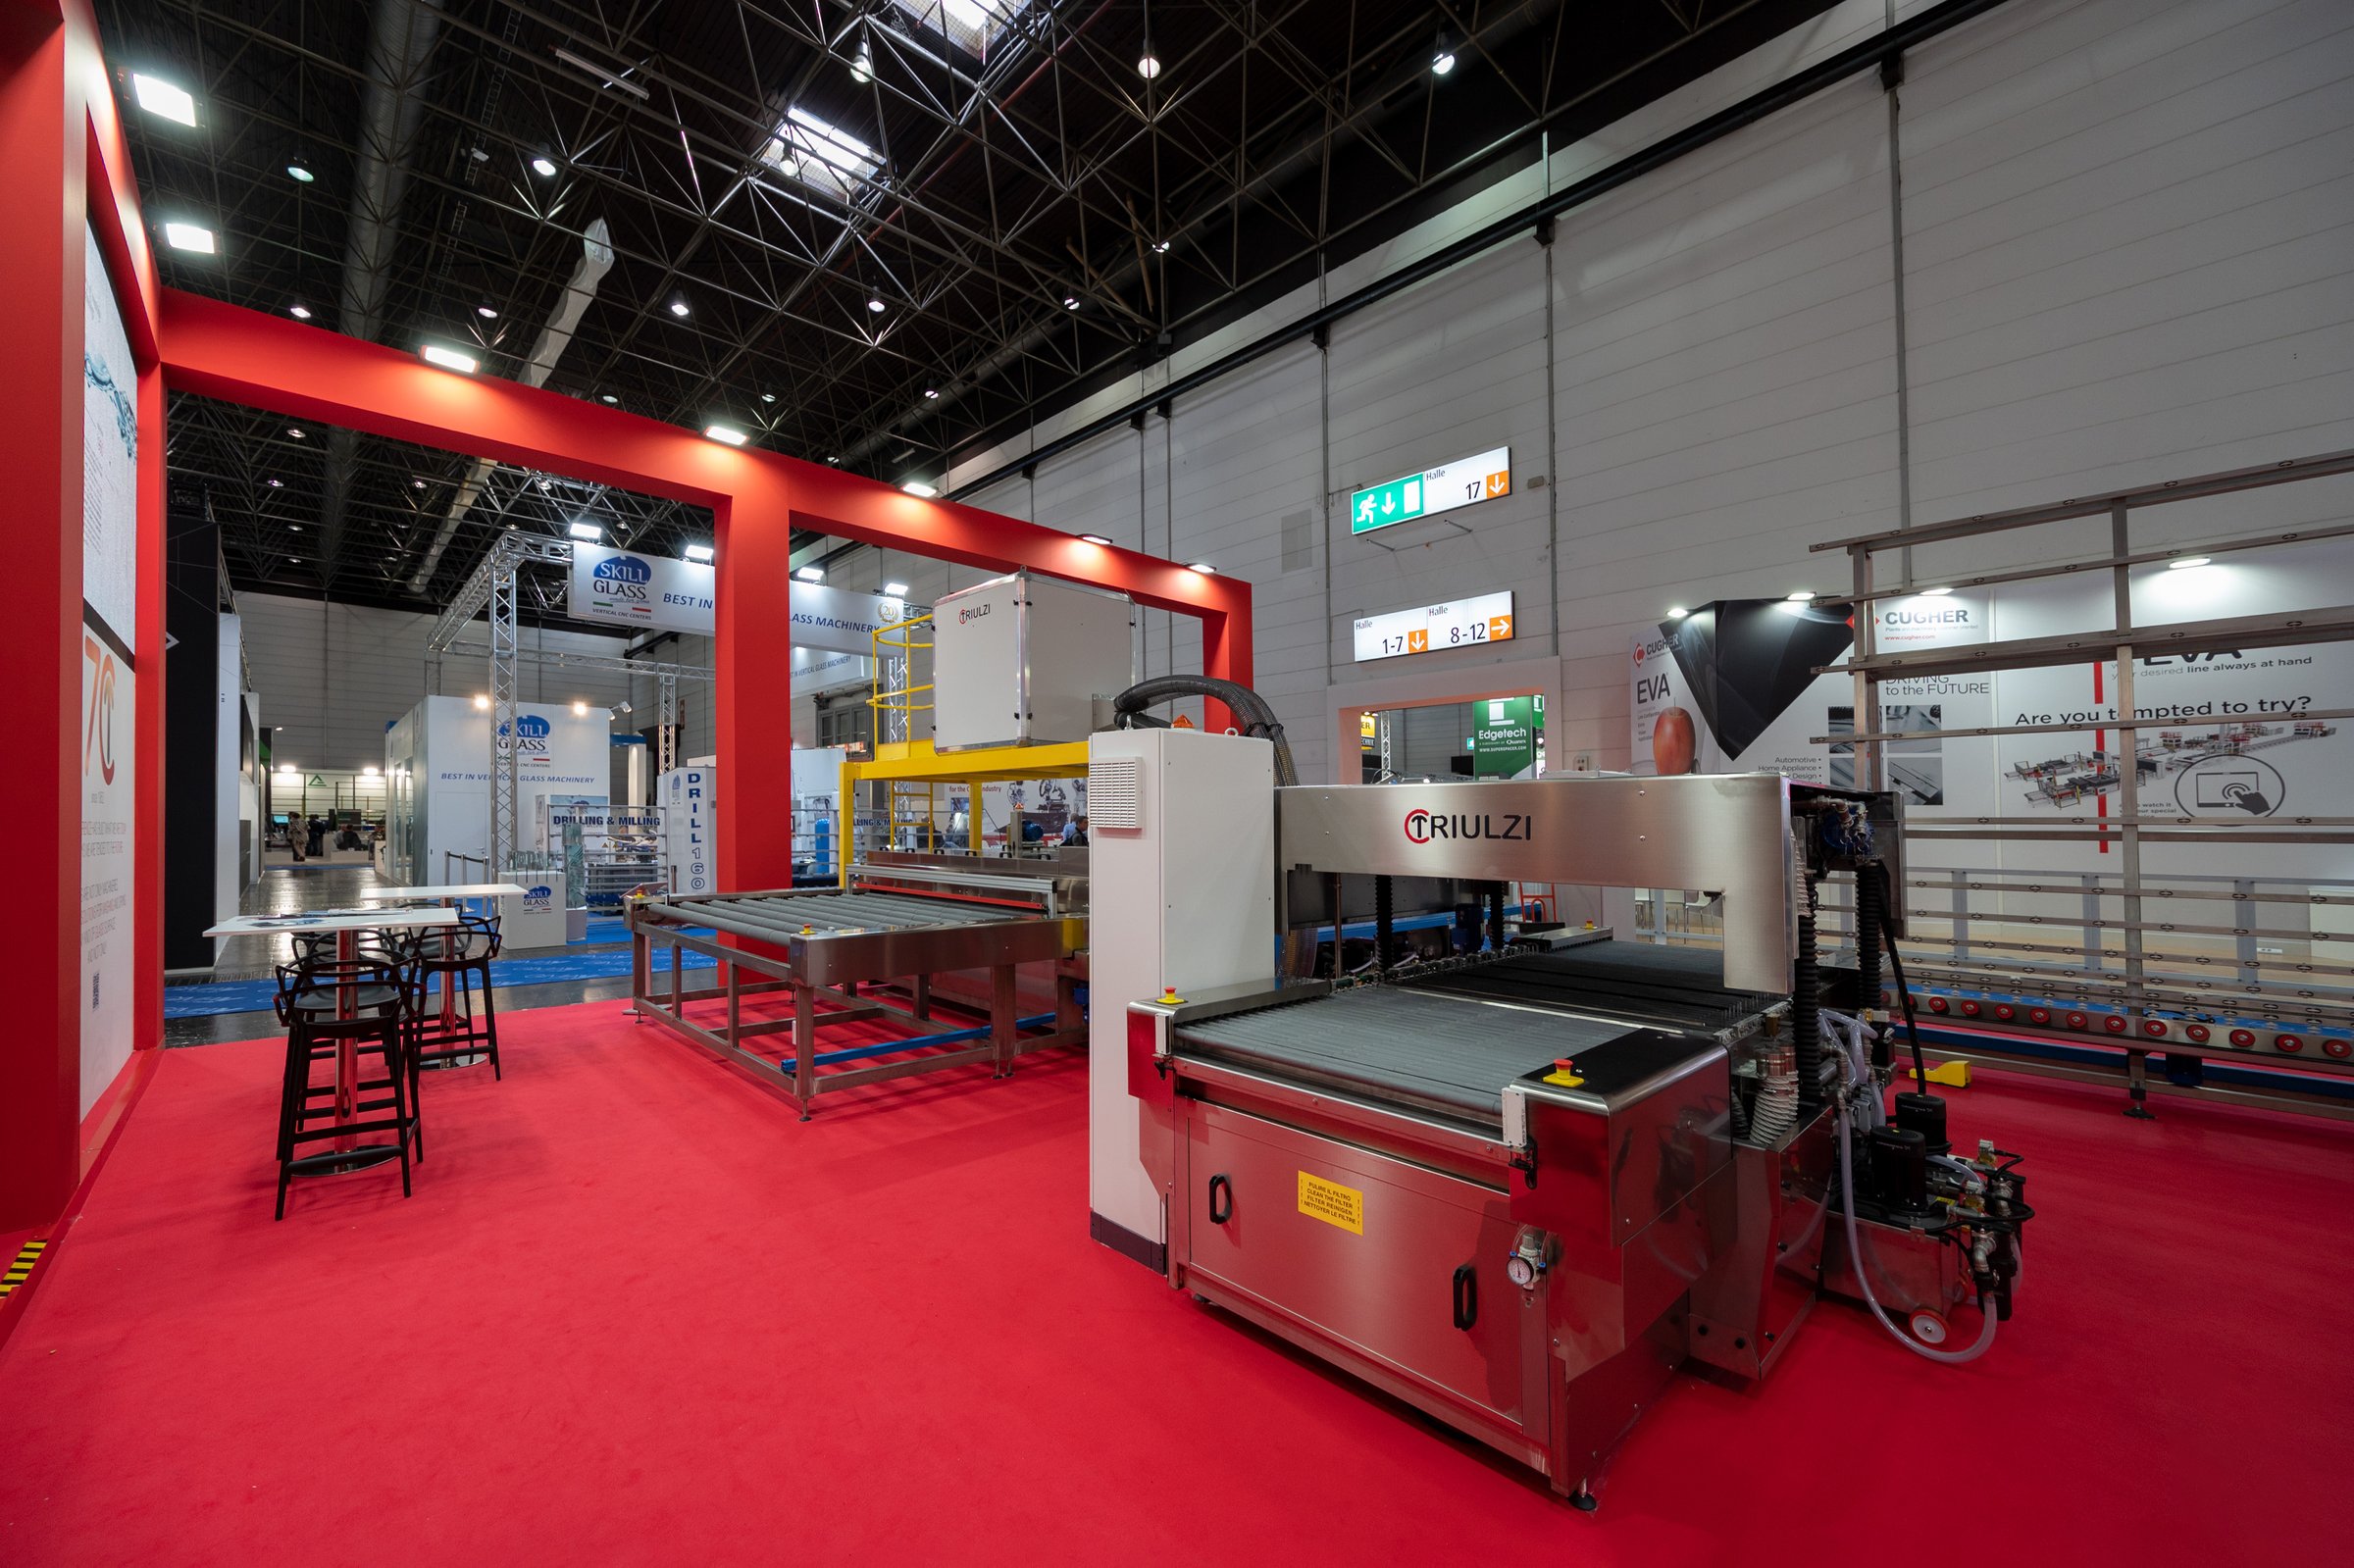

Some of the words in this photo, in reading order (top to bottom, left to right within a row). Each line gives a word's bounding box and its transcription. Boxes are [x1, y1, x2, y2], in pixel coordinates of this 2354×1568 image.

[1426, 469, 1446, 481] Halle
[1465, 481, 1481, 500] 17
[599, 562, 647, 583] SKILL
[593, 580, 646, 599] GLASS
[663, 593, 695, 607] BEST
[698, 598, 713, 609] IN
[959, 603, 991, 625] TRIULZI
[1429, 606, 1449, 617] Halle
[1884, 609, 1969, 626] CUGHER
[1356, 620, 1373, 630] Halle
[1382, 635, 1404, 654] 1-7
[1646, 633, 1679, 656] CUGHER
[827, 655, 851, 668] MACHINERY
[2140, 667, 2183, 677] desired
[2214, 662, 2257, 674] always
[2260, 659, 2273, 668] at
[2277, 655, 2312, 666] hand
[1637, 673, 1670, 704] EVA
[1886, 686, 1899, 695] to
[1903, 685, 1923, 695] the
[1927, 683, 1990, 694] FUTURE
[2015, 711, 2052, 727] Are
[2059, 707, 2100, 726] you
[2222, 700, 2249, 714] to
[2259, 695, 2312, 714] try?
[1478, 727, 1527, 741] Edgetech
[498, 738, 545, 750] GASS
[553, 816, 604, 826] DRILLING
[606, 816, 615, 826] &
[619, 816, 660, 826] MILLING
[1404, 808, 1531, 844] TRIULZI
[1307, 1189, 1323, 1198] CLEAN
[1335, 1198, 1353, 1209] FILTER
[1333, 1190, 1351, 1201] FILTRO
[1304, 1201, 1330, 1214] NETTOYER
[1339, 1213, 1356, 1224] FILTRE
[1307, 1195, 1325, 1205] FILTER
[1326, 1201, 1353, 1216] REINIGEN
